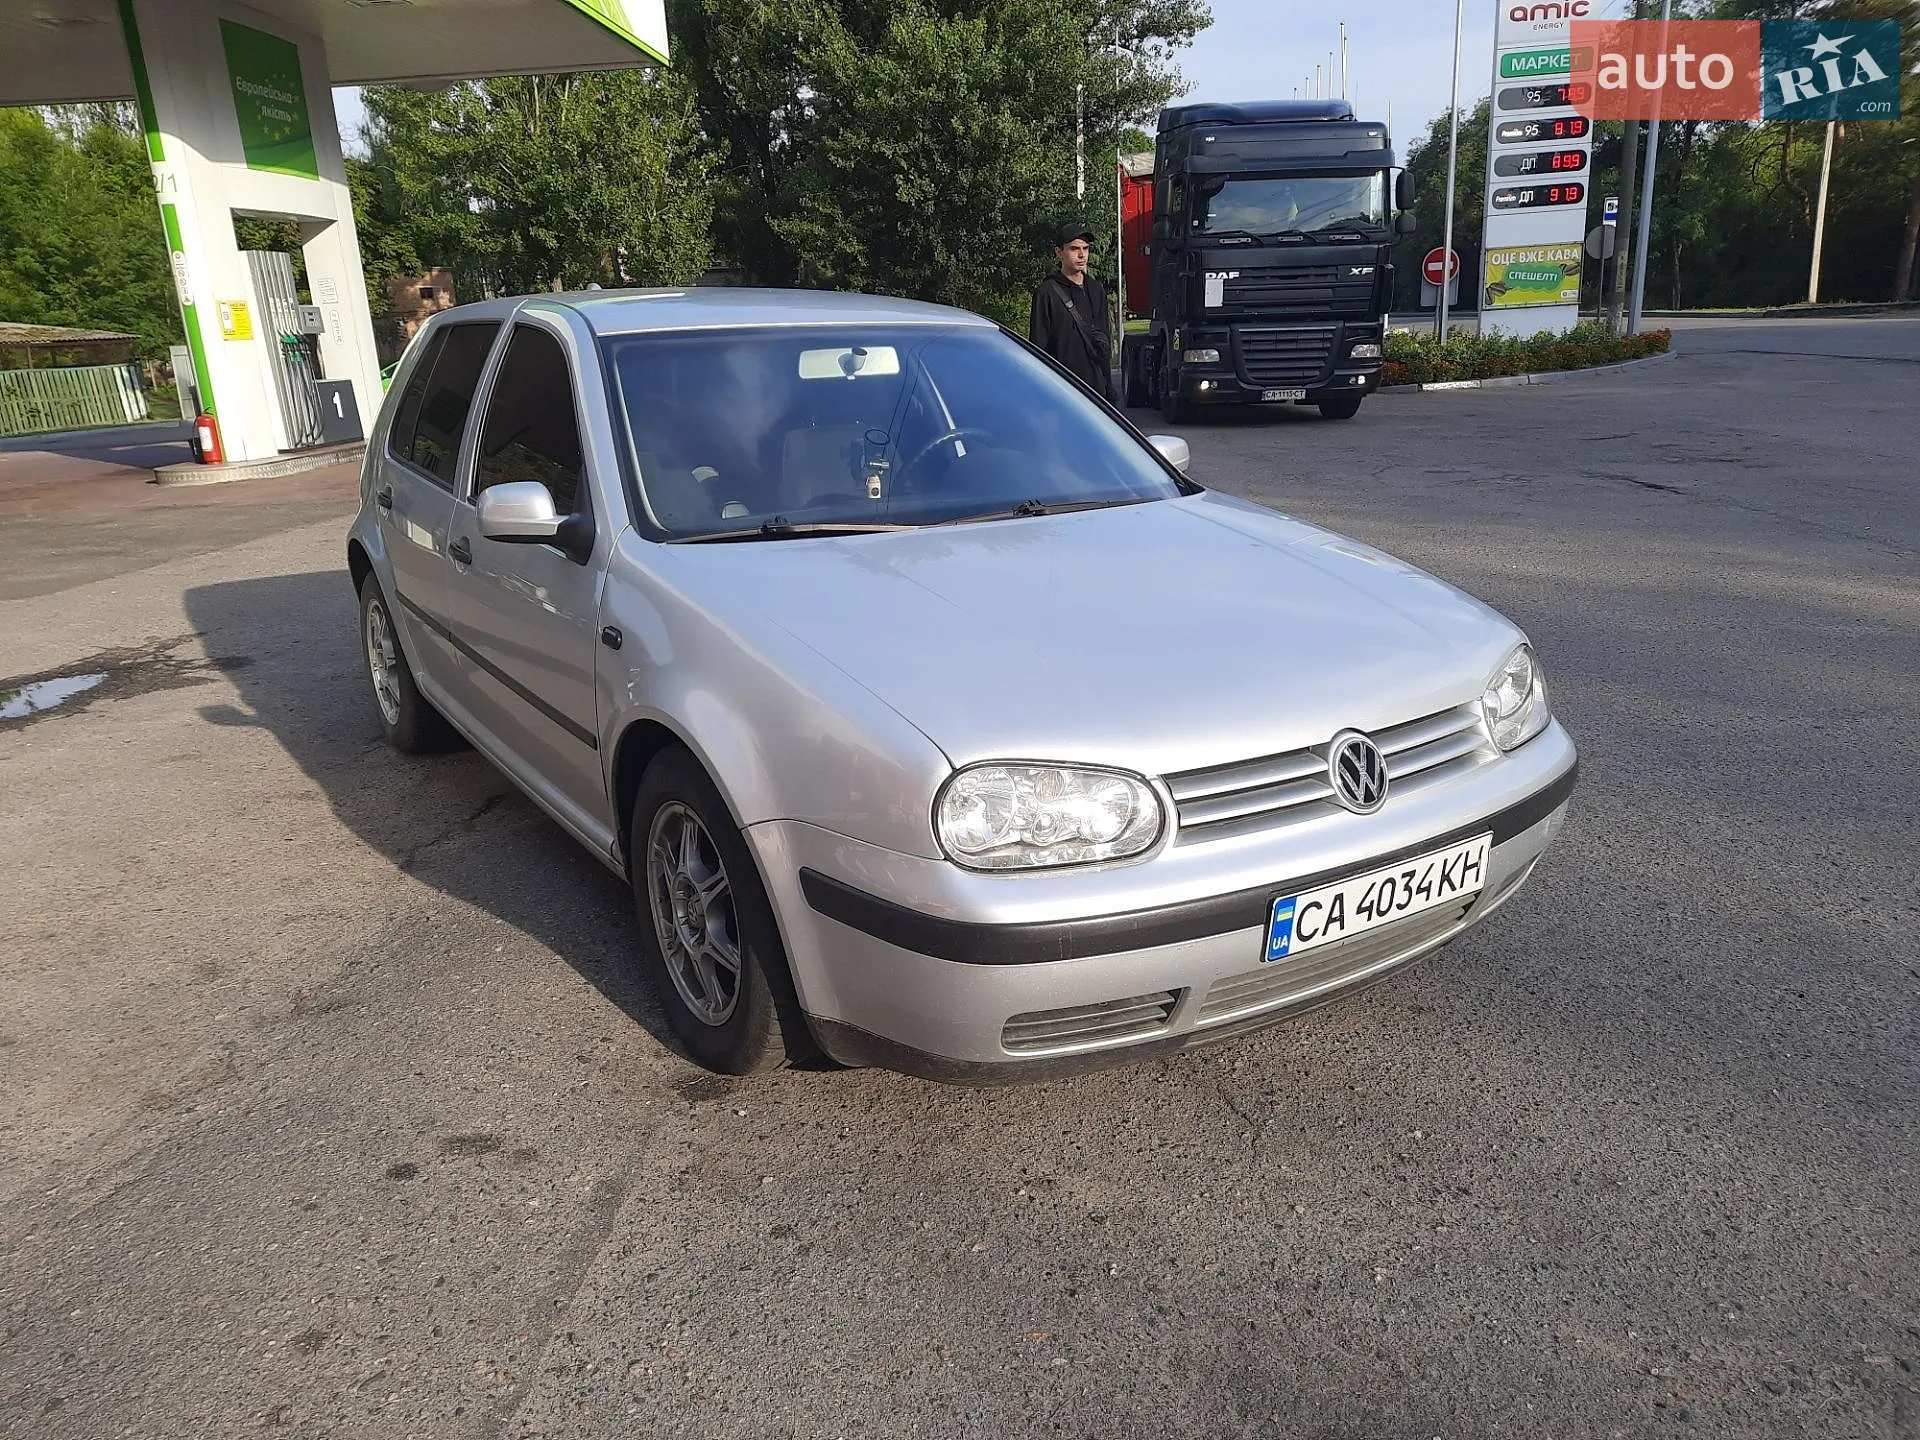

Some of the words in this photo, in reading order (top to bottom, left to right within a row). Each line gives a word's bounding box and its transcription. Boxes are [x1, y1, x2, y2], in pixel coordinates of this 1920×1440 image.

[1509, 0, 1590, 22] amic
[1533, 22, 1564, 31] ENERGY
[236, 76, 292, 104] Європейська
[1526, 91, 1541, 102] 95
[260, 104, 292, 122] якість
[1524, 124, 1540, 137] 95
[1520, 157, 1536, 171] ДП
[1518, 190, 1534, 204] ДП
[1492, 252, 1517, 265] ОЦЕ
[1519, 250, 1545, 263] ВЖЕ
[1547, 248, 1579, 261] КАВА
[1205, 271, 1240, 280] DAF
[1350, 267, 1374, 276] XF
[332, 391, 344, 418] 1
[1272, 936, 1289, 950] UA
